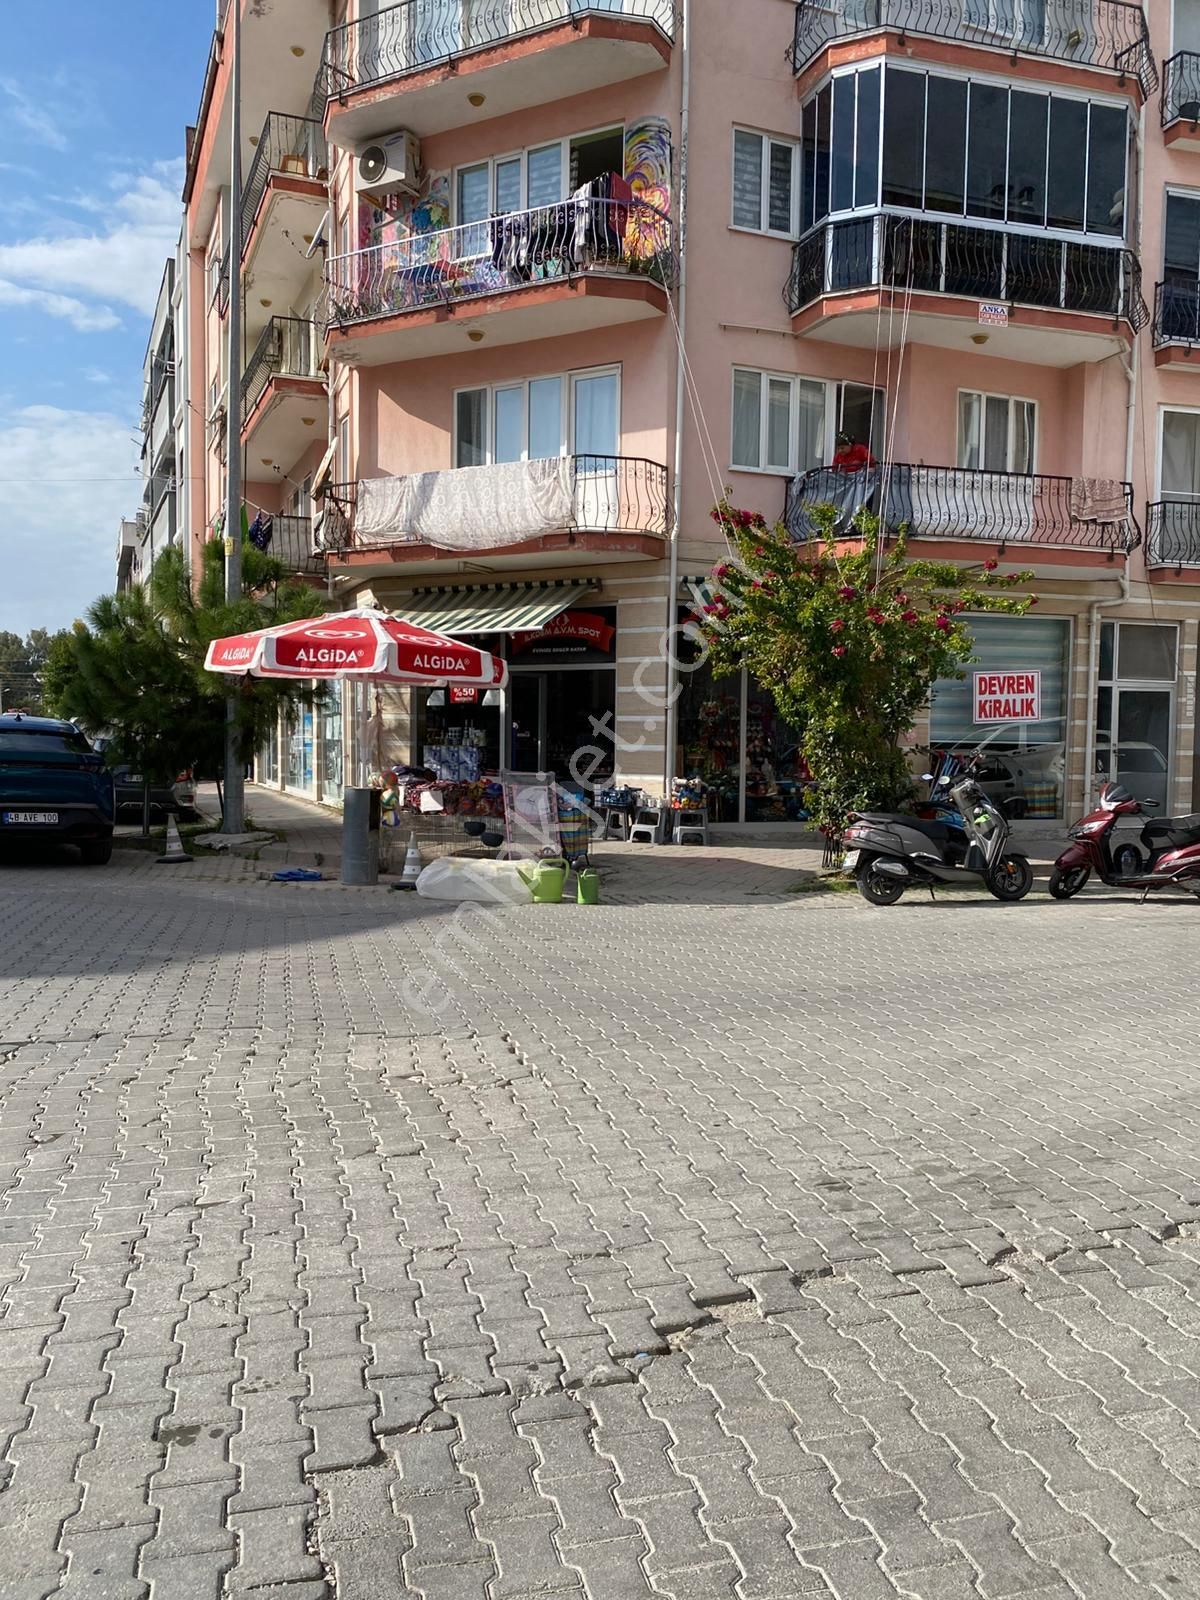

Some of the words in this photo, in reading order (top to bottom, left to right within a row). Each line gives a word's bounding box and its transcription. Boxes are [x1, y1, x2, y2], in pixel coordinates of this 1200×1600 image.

[982, 306, 1005, 314] ANKA
[578, 627, 601, 638] SPOT
[978, 675, 1035, 695] DEVREN
[453, 687, 475, 697] %50
[23, 813, 38, 822] AVE
[42, 813, 57, 822] 100
